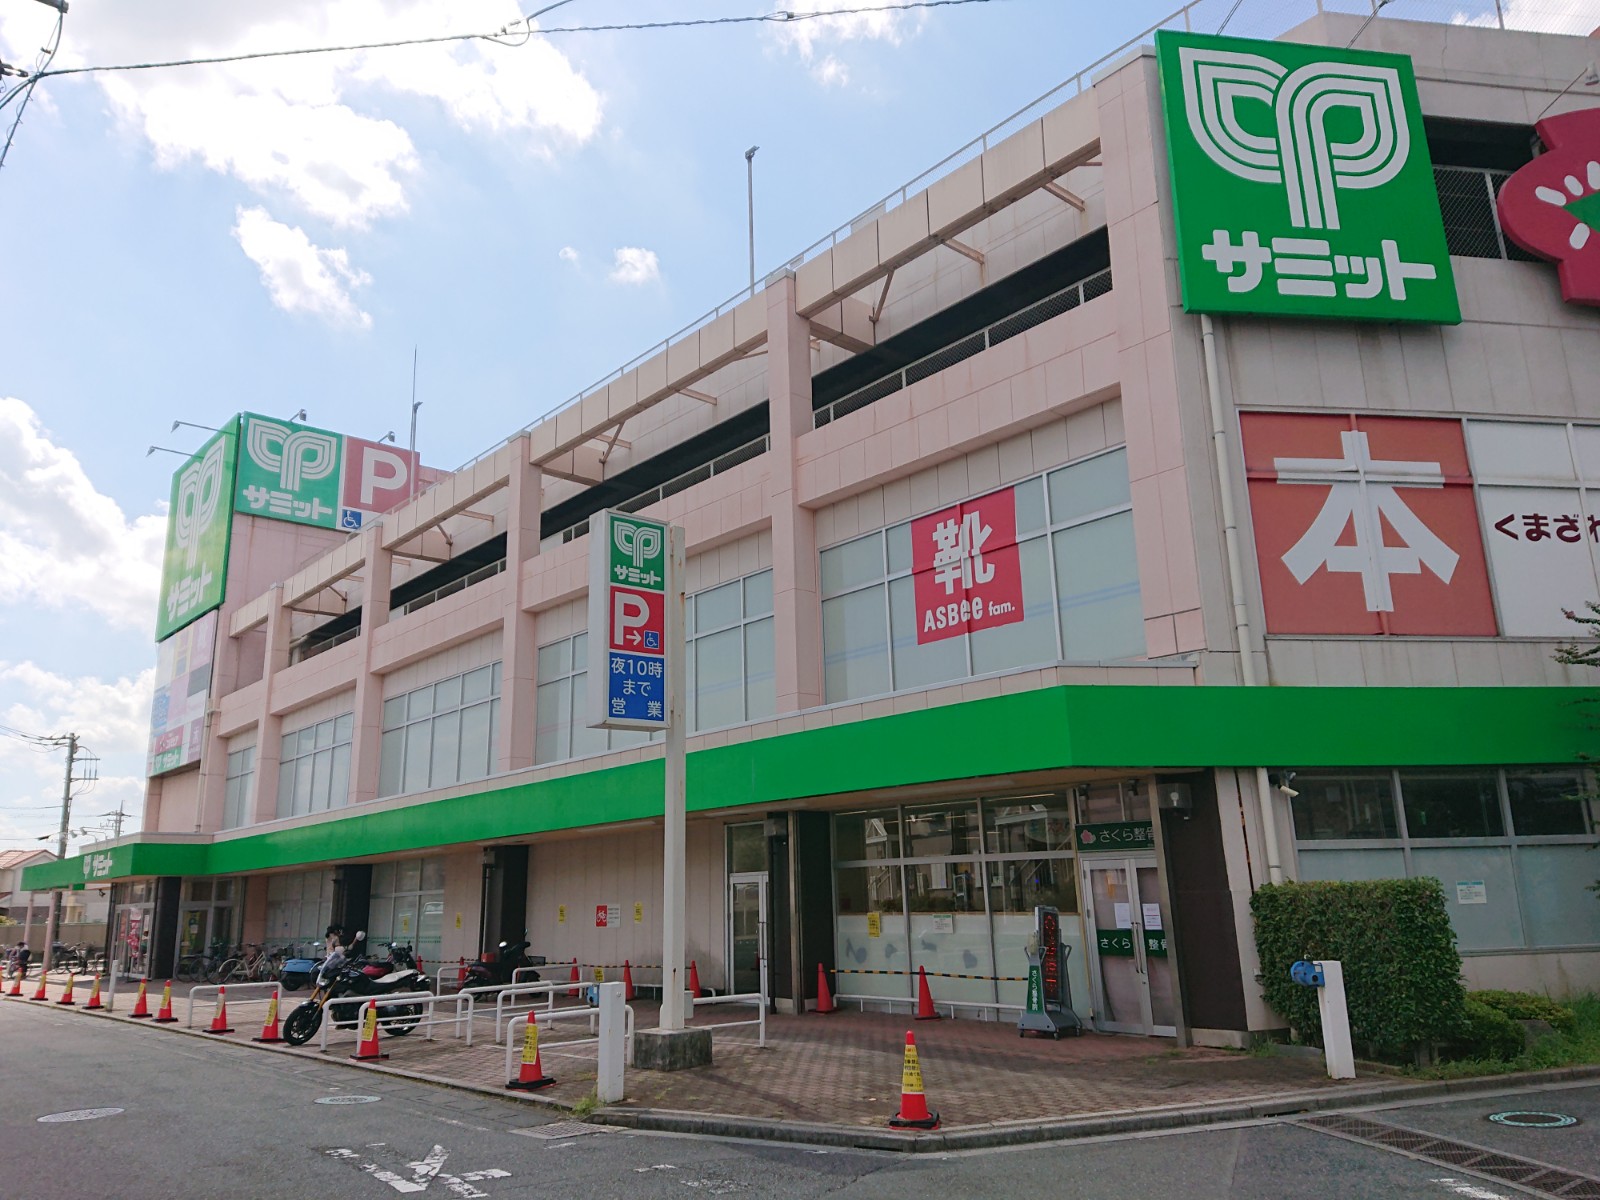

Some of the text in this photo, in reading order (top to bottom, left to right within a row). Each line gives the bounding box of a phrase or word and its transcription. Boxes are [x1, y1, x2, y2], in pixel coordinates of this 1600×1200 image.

[1201, 229, 1436, 300] サミット
[360, 446, 408, 504] P
[242, 484, 332, 519] サミット
[1274, 430, 1460, 612] 本
[614, 564, 661, 585] サミット
[932, 510, 995, 595] 靴
[167, 563, 212, 621] サミット
[924, 596, 1015, 633] ASBee fam.
[614, 591, 650, 646] P
[611, 657, 663, 679] 夜10時
[623, 679, 651, 697] まで
[92, 852, 113, 878] サミット
